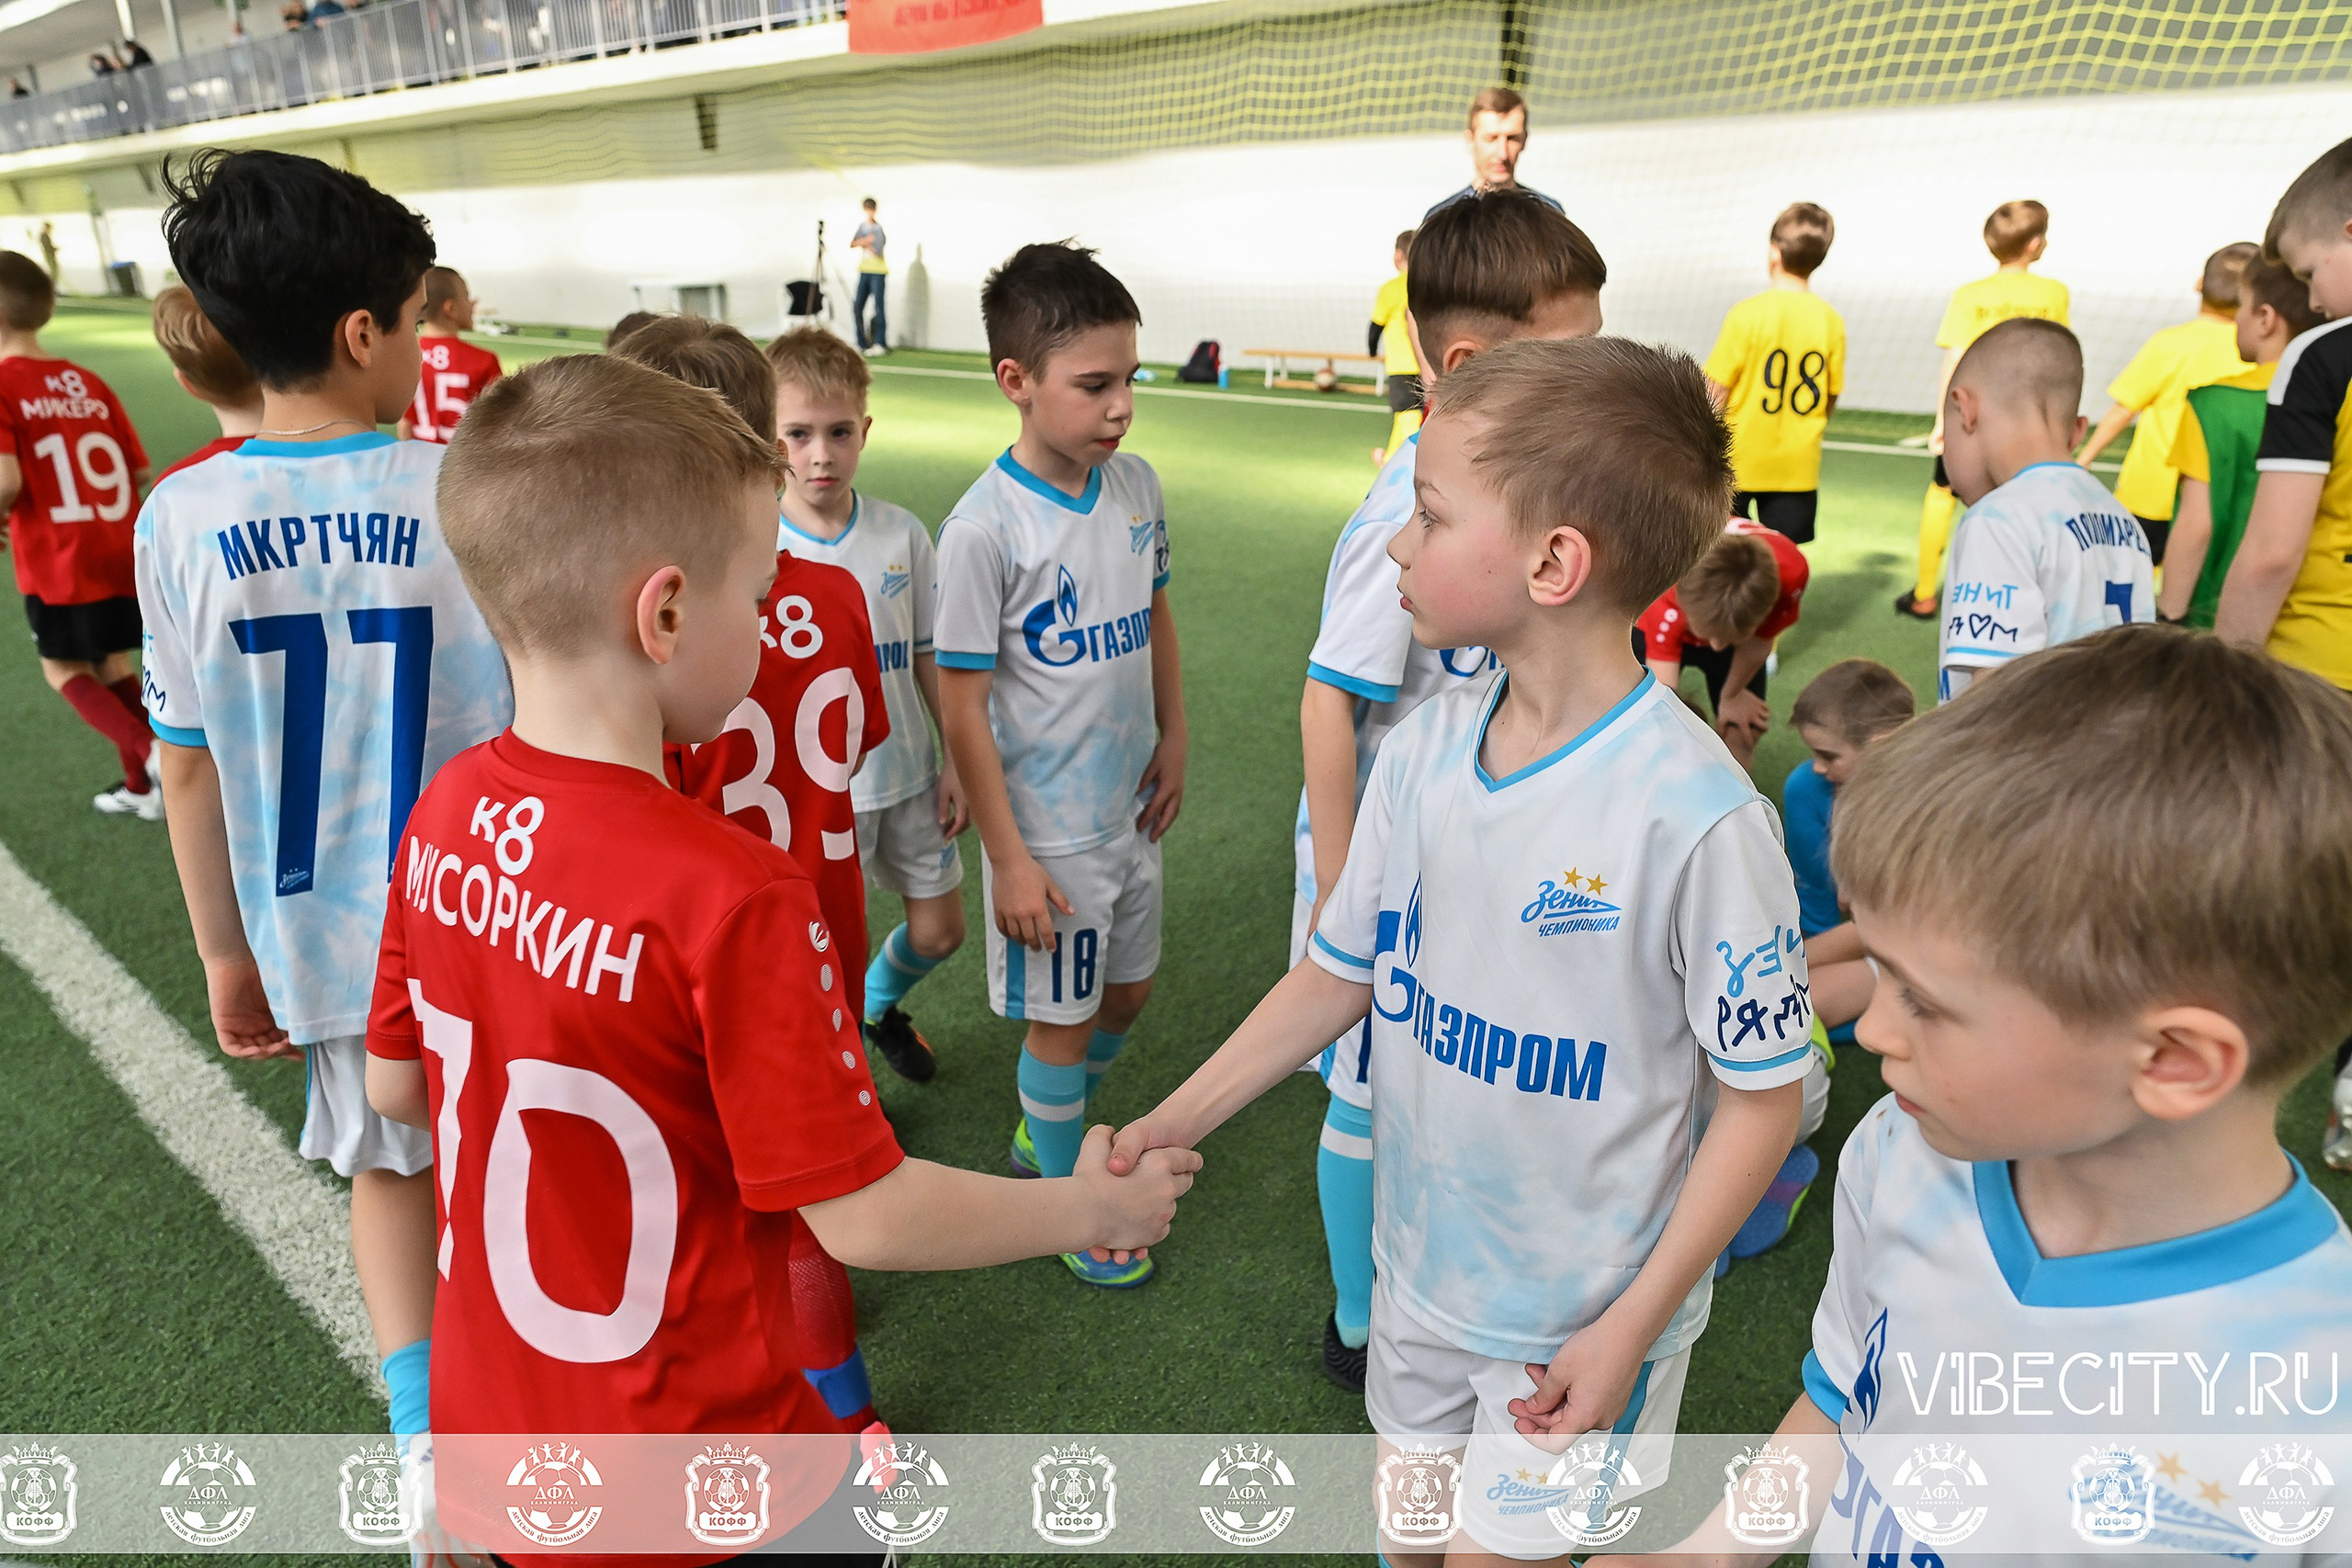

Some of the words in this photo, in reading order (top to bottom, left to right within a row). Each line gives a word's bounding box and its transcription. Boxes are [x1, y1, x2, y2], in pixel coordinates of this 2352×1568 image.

[413, 372, 470, 440] 15
[1762, 349, 1824, 415] 98
[34, 431, 131, 524] 19
[217, 513, 420, 581] МКРТЧЯН
[228, 605, 435, 897] 77
[702, 667, 865, 861] 39
[406, 835, 645, 1003] МУСОРКИН
[1521, 880, 1623, 923] Зенит
[1539, 916, 1620, 937] ЧЕМПИОНИКА
[1051, 928, 1097, 1004] 18
[1413, 981, 1607, 1102] ГАЗПРОМ
